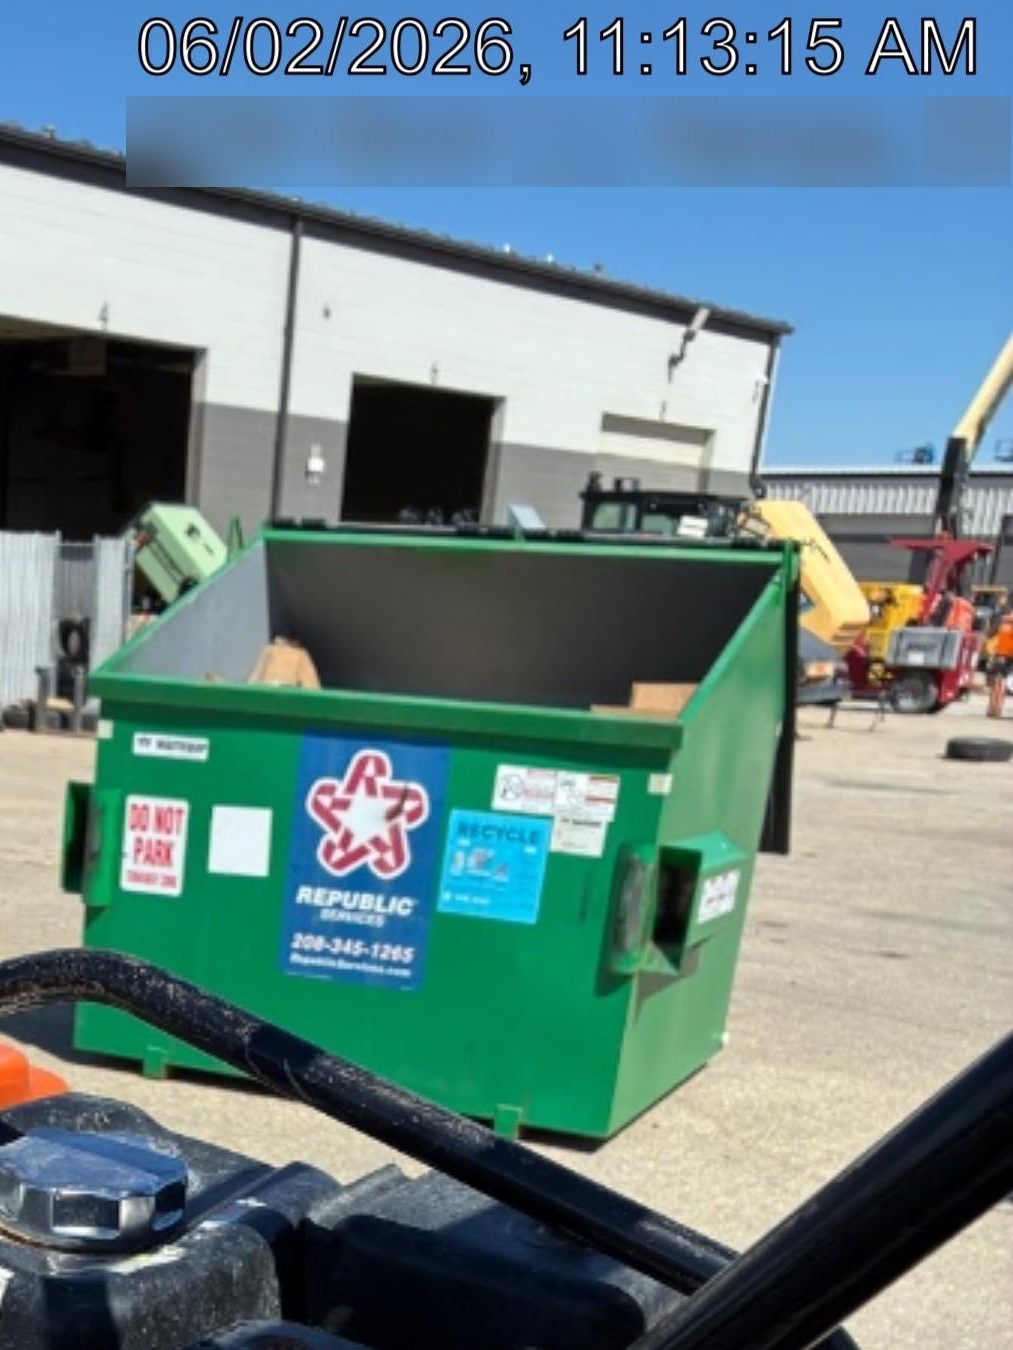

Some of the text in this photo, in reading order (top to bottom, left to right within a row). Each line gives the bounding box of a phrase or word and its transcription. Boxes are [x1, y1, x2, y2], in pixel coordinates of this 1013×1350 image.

[130, 803, 184, 835] DO NOT
[457, 822, 541, 846] RECYCLE
[133, 836, 174, 867] PARK
[295, 884, 415, 916] REPUBLIC
